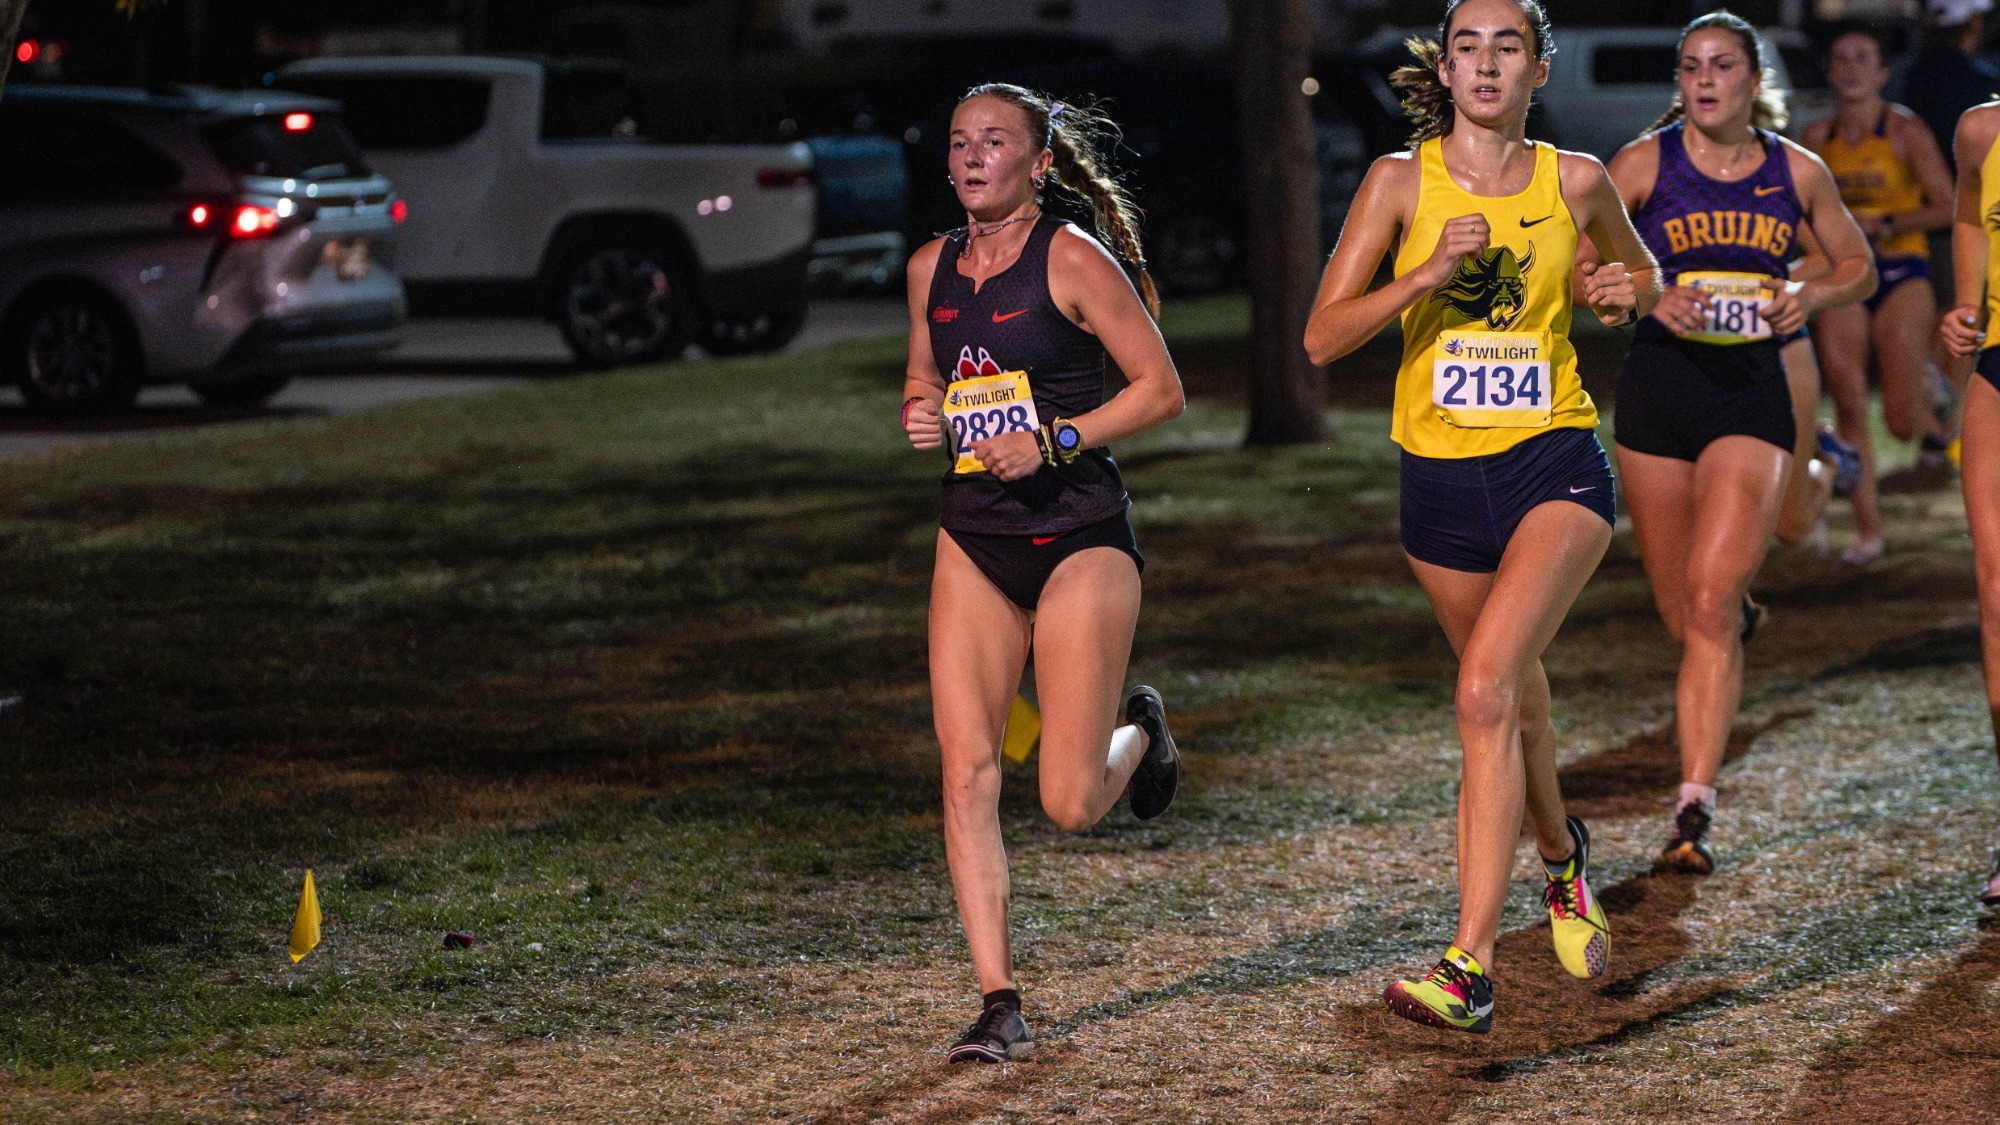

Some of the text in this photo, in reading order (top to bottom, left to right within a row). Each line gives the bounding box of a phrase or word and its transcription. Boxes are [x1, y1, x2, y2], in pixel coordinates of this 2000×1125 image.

[1663, 211, 1792, 257] BRUINS
[1701, 300, 1759, 333] 181
[1466, 337, 1538, 348] AUGUSTANA
[1466, 347, 1538, 359] TWILIGHT
[963, 388, 1016, 407] TWILIGHT
[1443, 365, 1542, 406] 2134
[952, 405, 1032, 454] 2828
